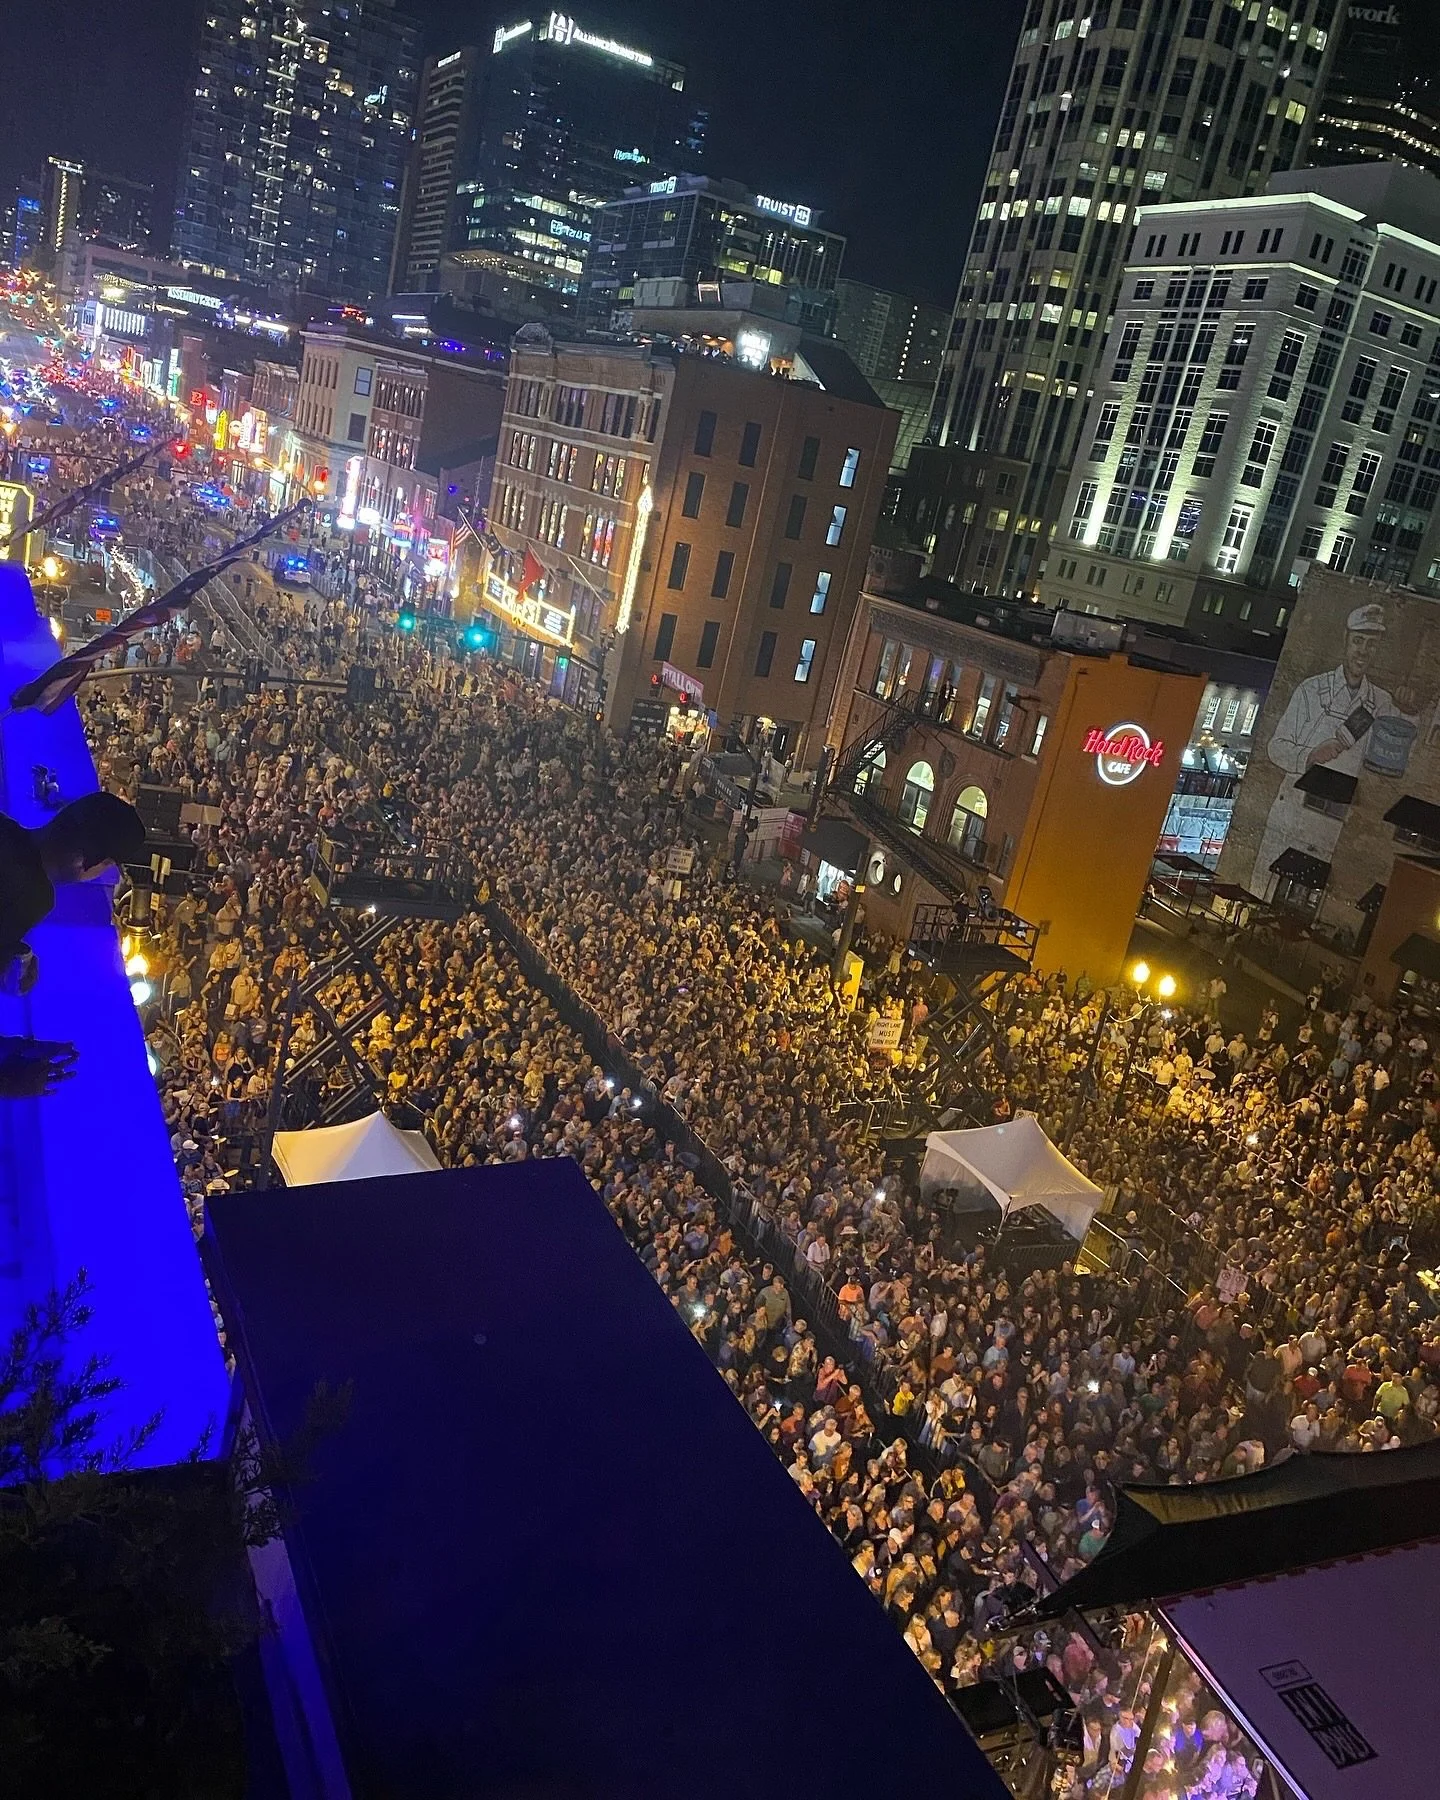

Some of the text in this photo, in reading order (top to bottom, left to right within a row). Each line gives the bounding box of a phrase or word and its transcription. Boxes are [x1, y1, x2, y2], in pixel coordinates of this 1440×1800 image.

[1347, 5, 1400, 24] work
[756, 194, 796, 217] TRUIST
[1083, 729, 1164, 767] Hard Rock
[1107, 761, 1132, 775] CAFE
